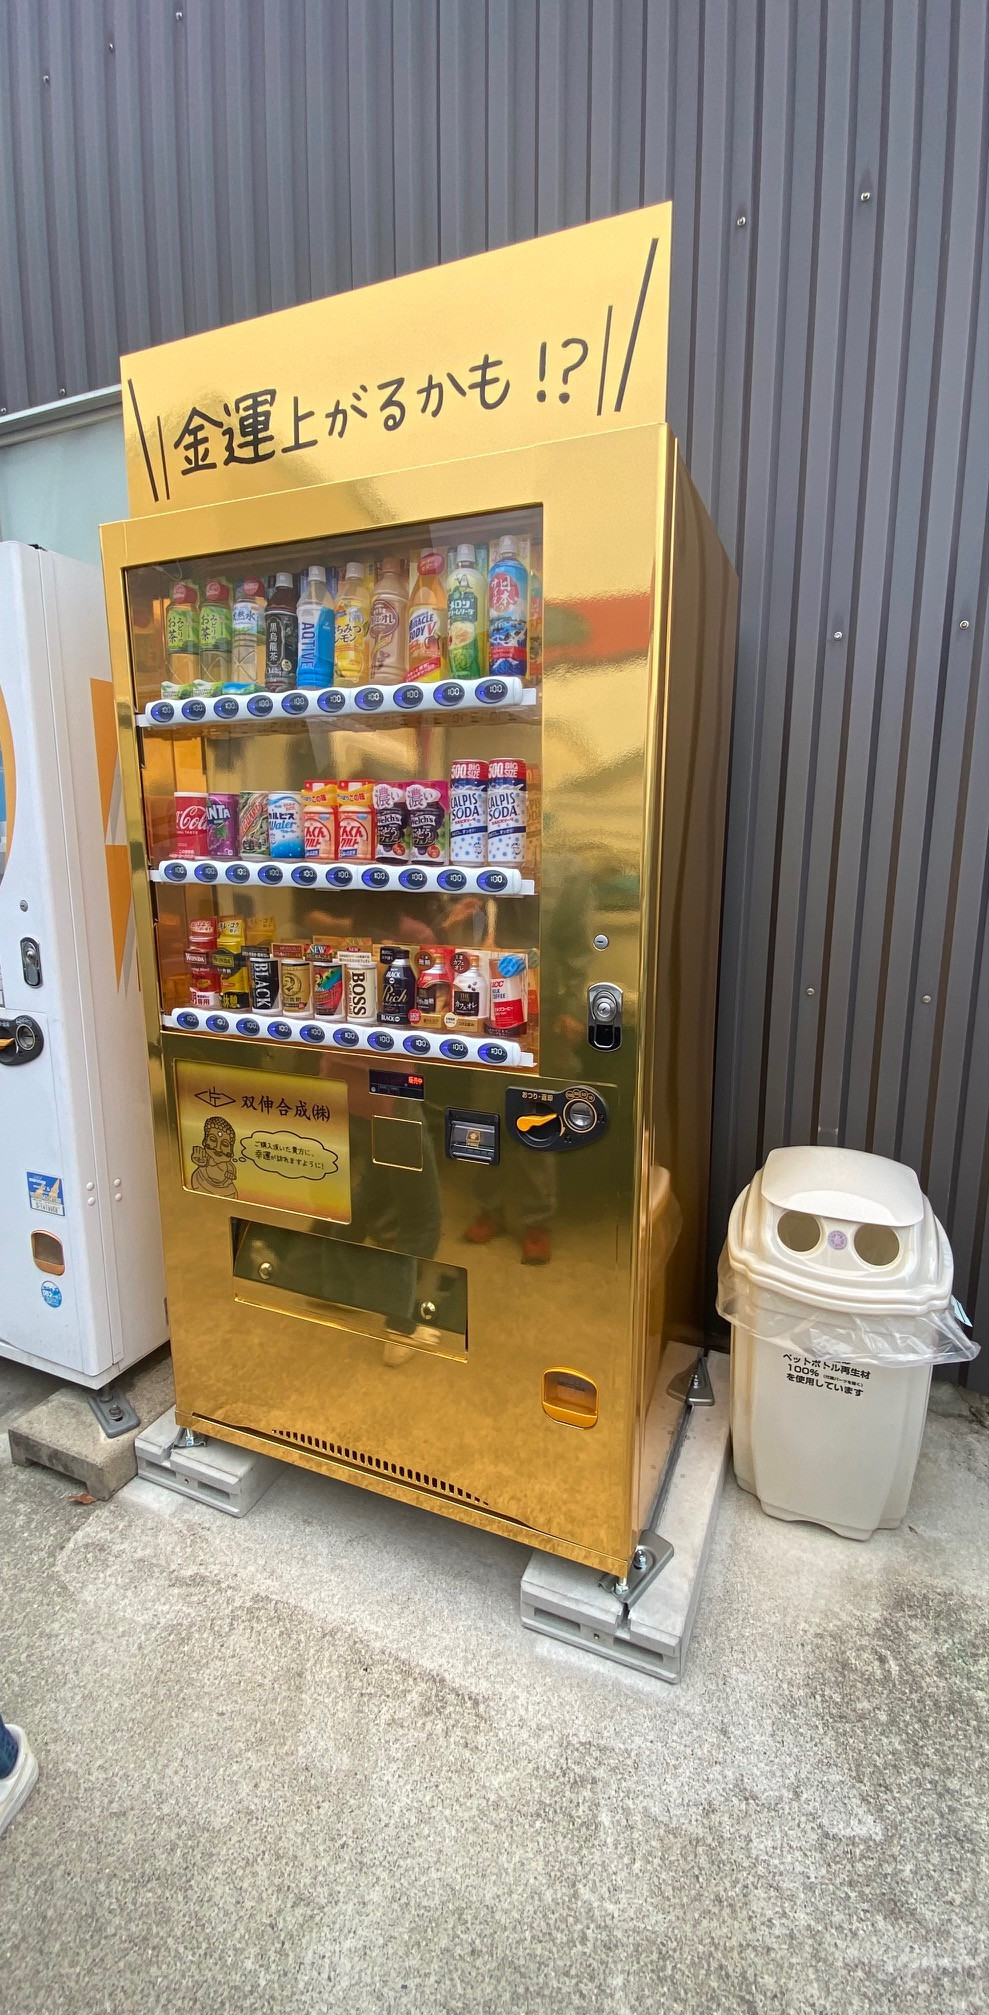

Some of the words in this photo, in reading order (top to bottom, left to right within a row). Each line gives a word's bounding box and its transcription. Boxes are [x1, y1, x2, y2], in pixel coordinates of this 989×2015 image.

[173, 354, 510, 476] 金運上がるかも
[168, 616, 178, 644] お茶
[200, 613, 211, 642] お茶
[335, 623, 362, 634] ちみつ
[269, 622, 278, 661] 黒烏龍茶
[301, 621, 316, 669] AQTIVE
[406, 690, 419, 698] 100
[447, 687, 460, 695] 100
[489, 684, 503, 693] 100
[368, 692, 380, 701] 100
[375, 787, 400, 807] 濃い
[407, 788, 433, 807] 濃い
[452, 805, 480, 822] SODA
[489, 805, 518, 822] SODA
[305, 826, 326, 838] んぐん
[374, 872, 385, 880] 100
[411, 873, 423, 881] 100
[450, 874, 462, 882] 100
[309, 945, 327, 954] NEW
[254, 962, 271, 1008] BLACK
[352, 972, 367, 1016] BOSS
[382, 985, 407, 1003] Rich
[455, 1001, 477, 1010] カフェオレ
[381, 1014, 395, 1022] BLACK
[415, 1039, 426, 1047] 100
[452, 1043, 463, 1051] 100
[490, 1047, 502, 1055] 100
[782, 1353, 871, 1380] ペットボトル再生材
[787, 1363, 820, 1377] 100%
[786, 1373, 864, 1397] を使用しています
